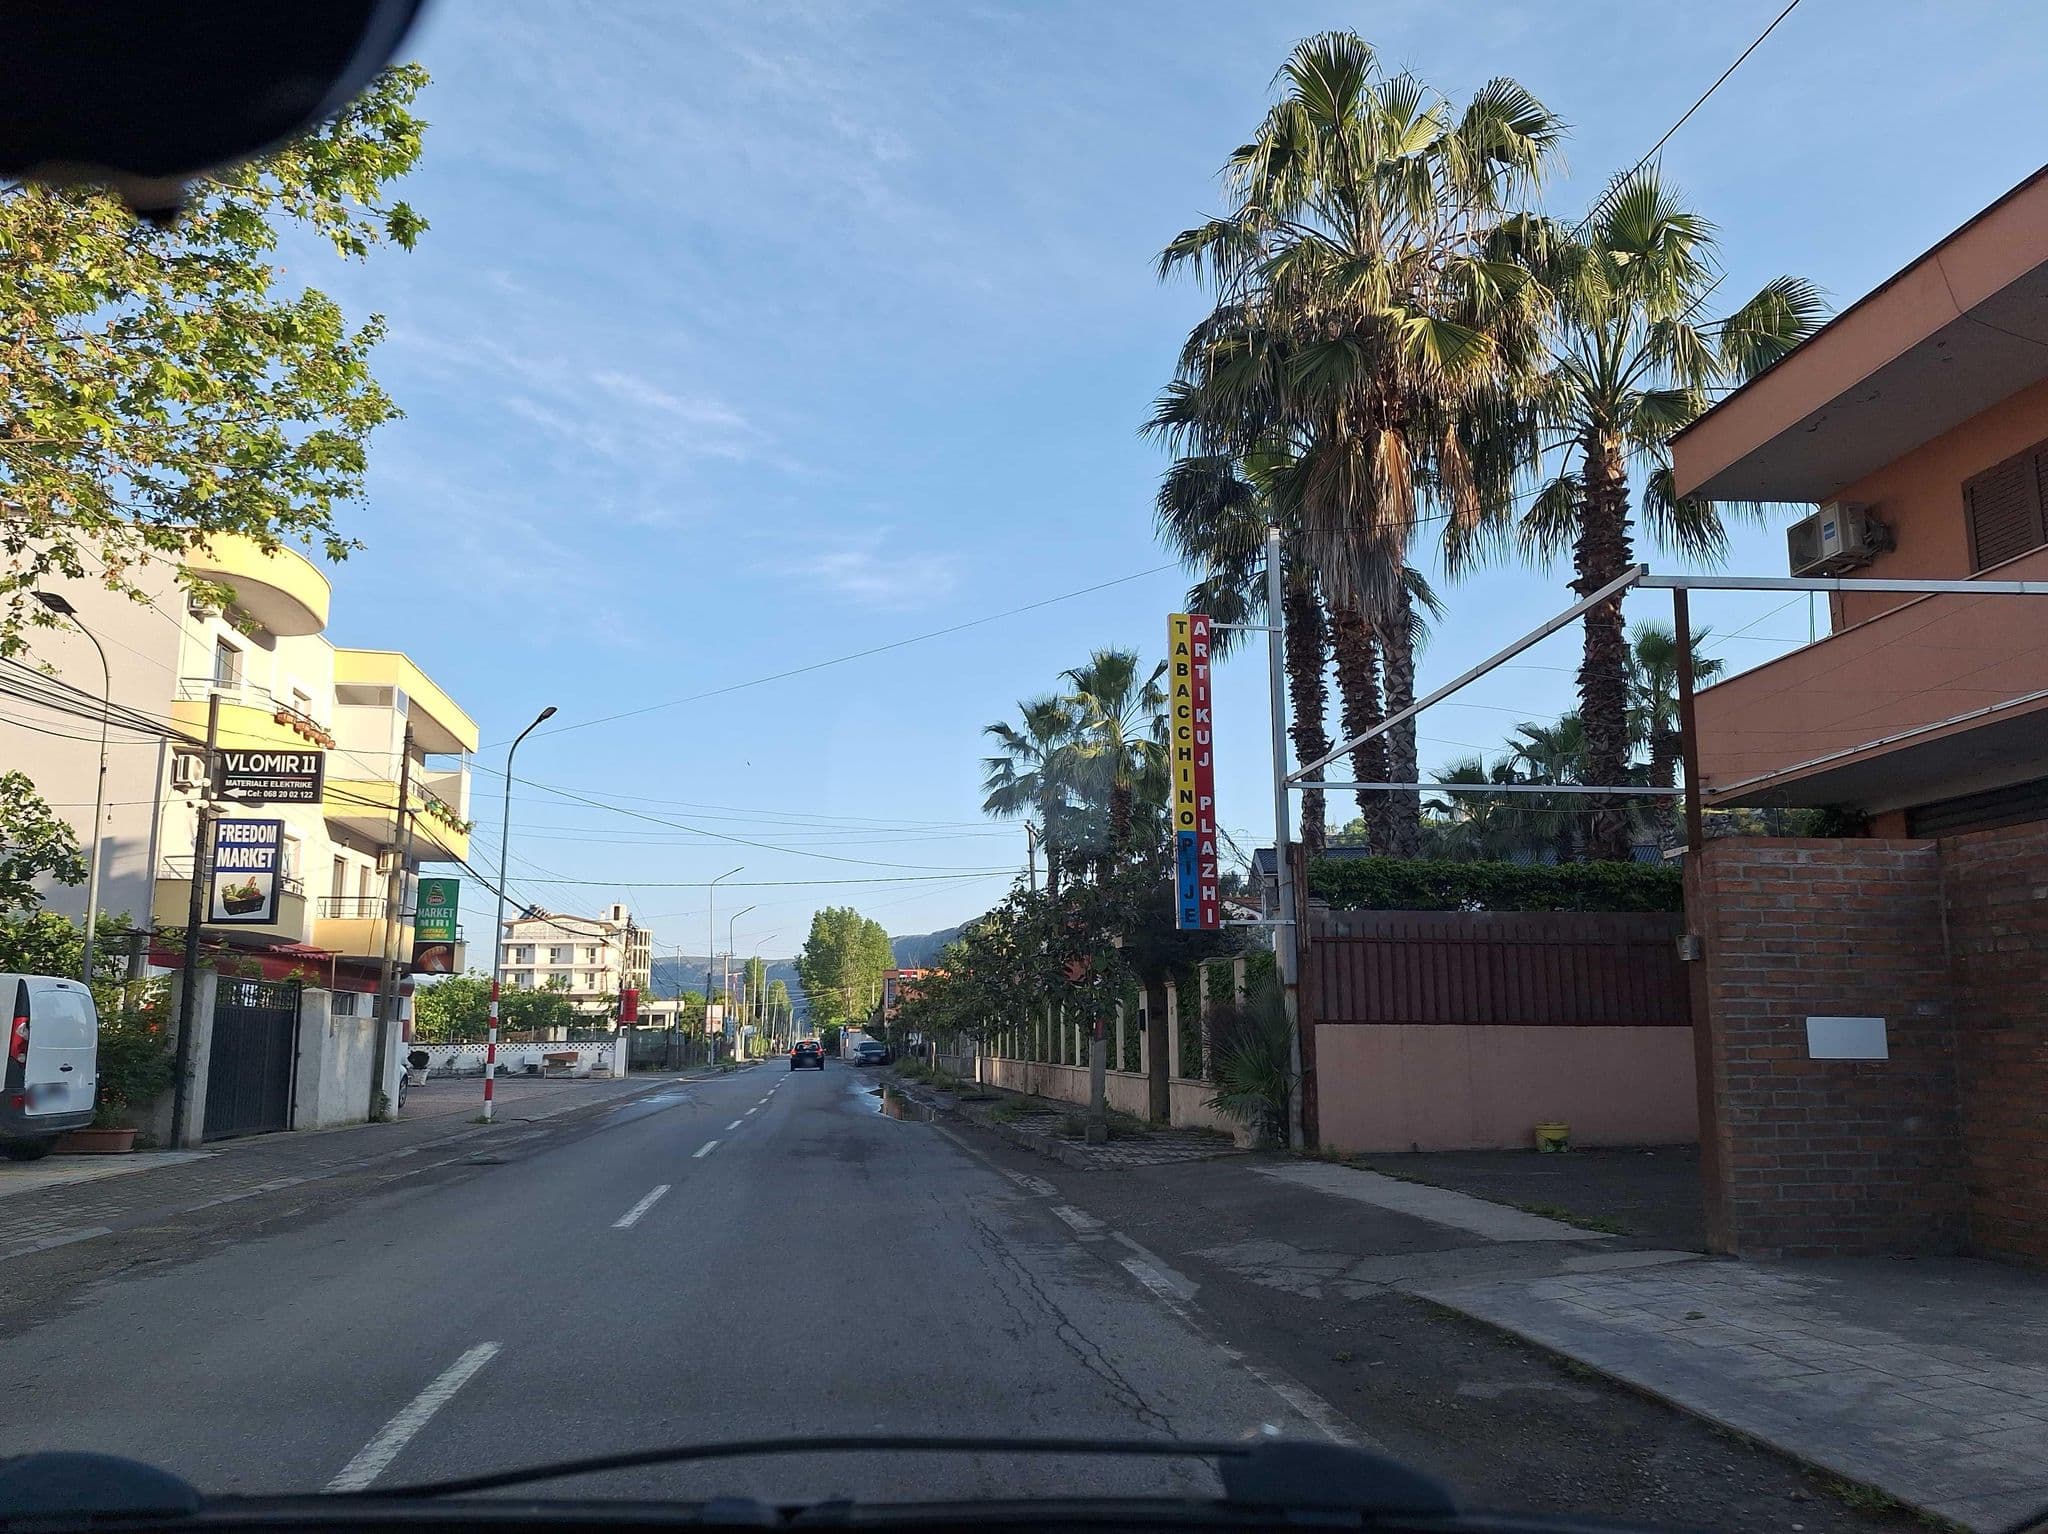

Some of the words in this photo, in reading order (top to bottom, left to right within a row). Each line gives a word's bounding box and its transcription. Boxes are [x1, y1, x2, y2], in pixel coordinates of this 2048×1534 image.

[1193, 621, 1210, 767] ARTIKUJ
[1176, 621, 1194, 825] TABACCHINO
[225, 754, 299, 773] VLOMIR
[216, 847, 275, 867] MARKET
[219, 824, 277, 843] FREEDOM
[1200, 796, 1216, 923] PLAZHI
[1182, 838, 1196, 923] PIJE
[418, 908, 454, 918] MARKET
